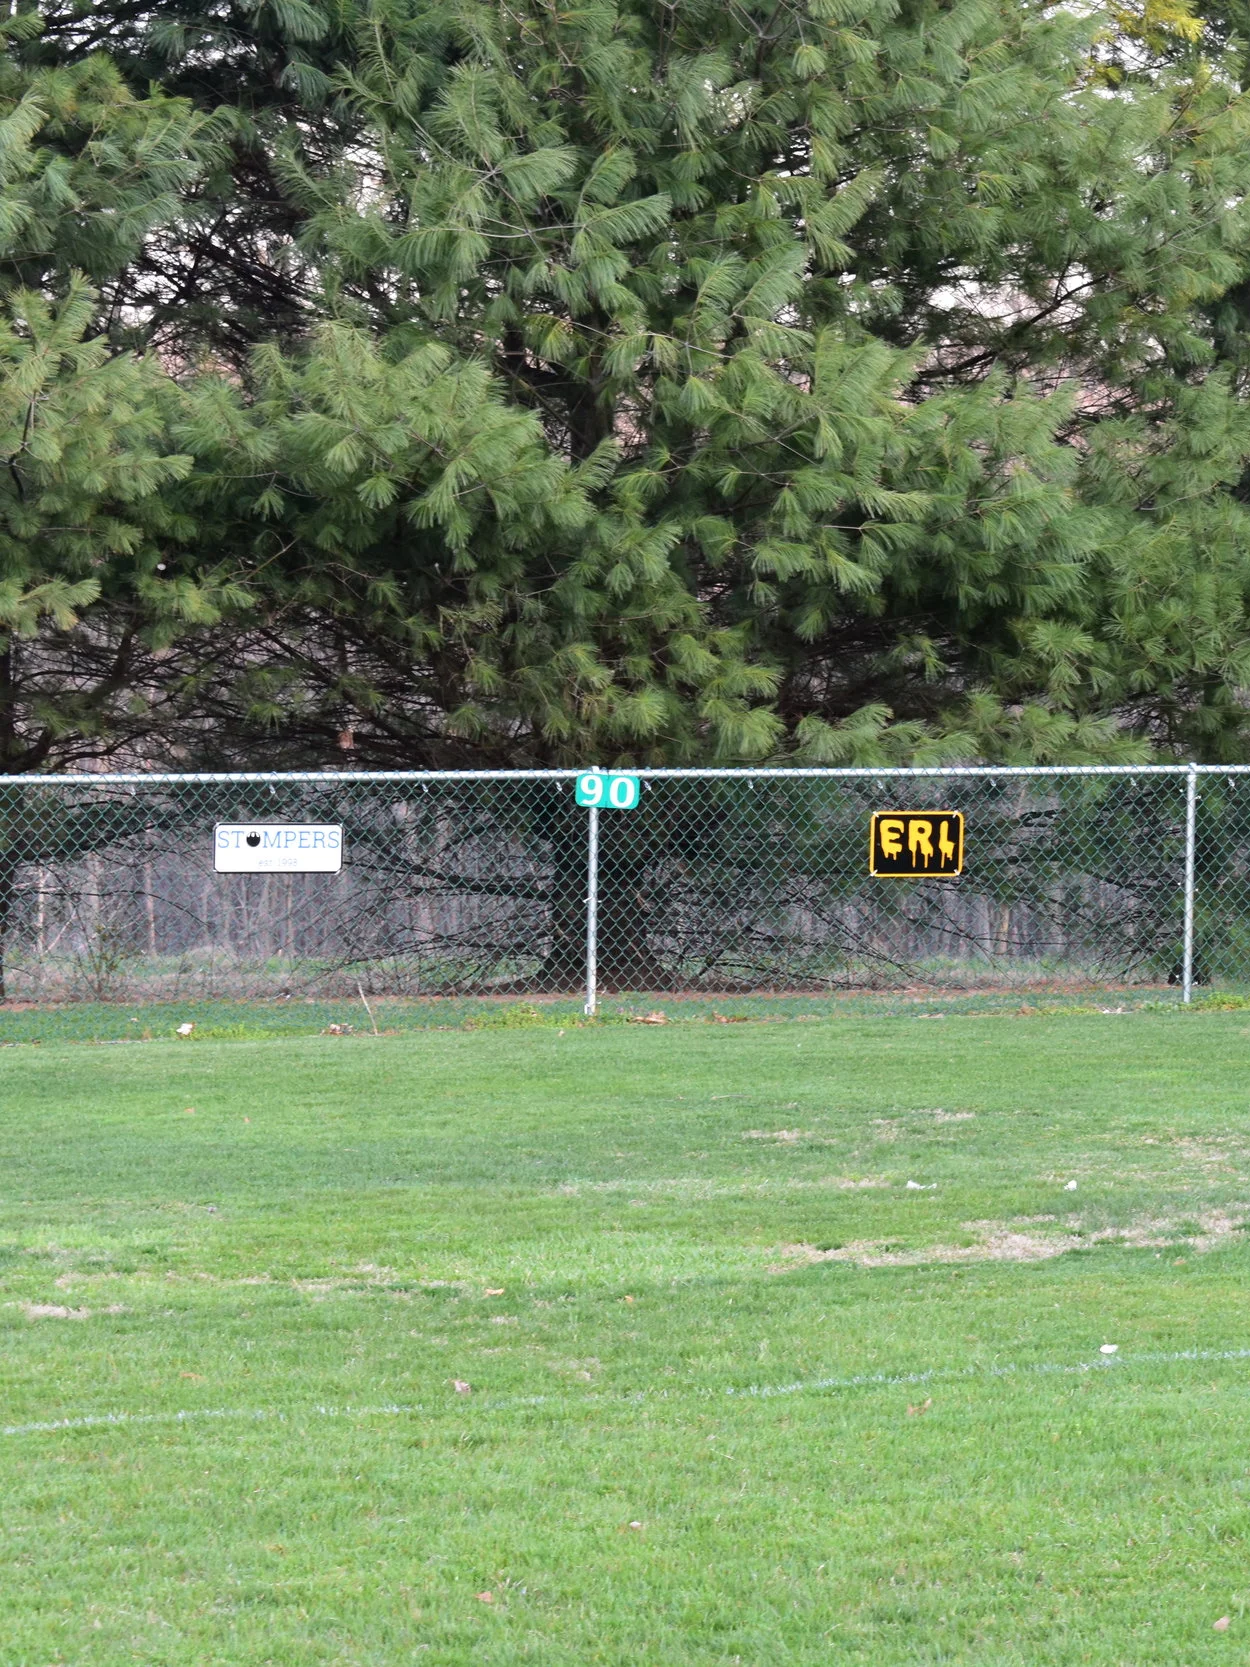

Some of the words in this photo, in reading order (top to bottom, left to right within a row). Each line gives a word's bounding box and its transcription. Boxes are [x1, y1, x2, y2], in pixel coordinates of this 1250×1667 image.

[580, 774, 635, 808] 90
[217, 831, 340, 849] STOMPERS
[880, 819, 955, 869] ERL
